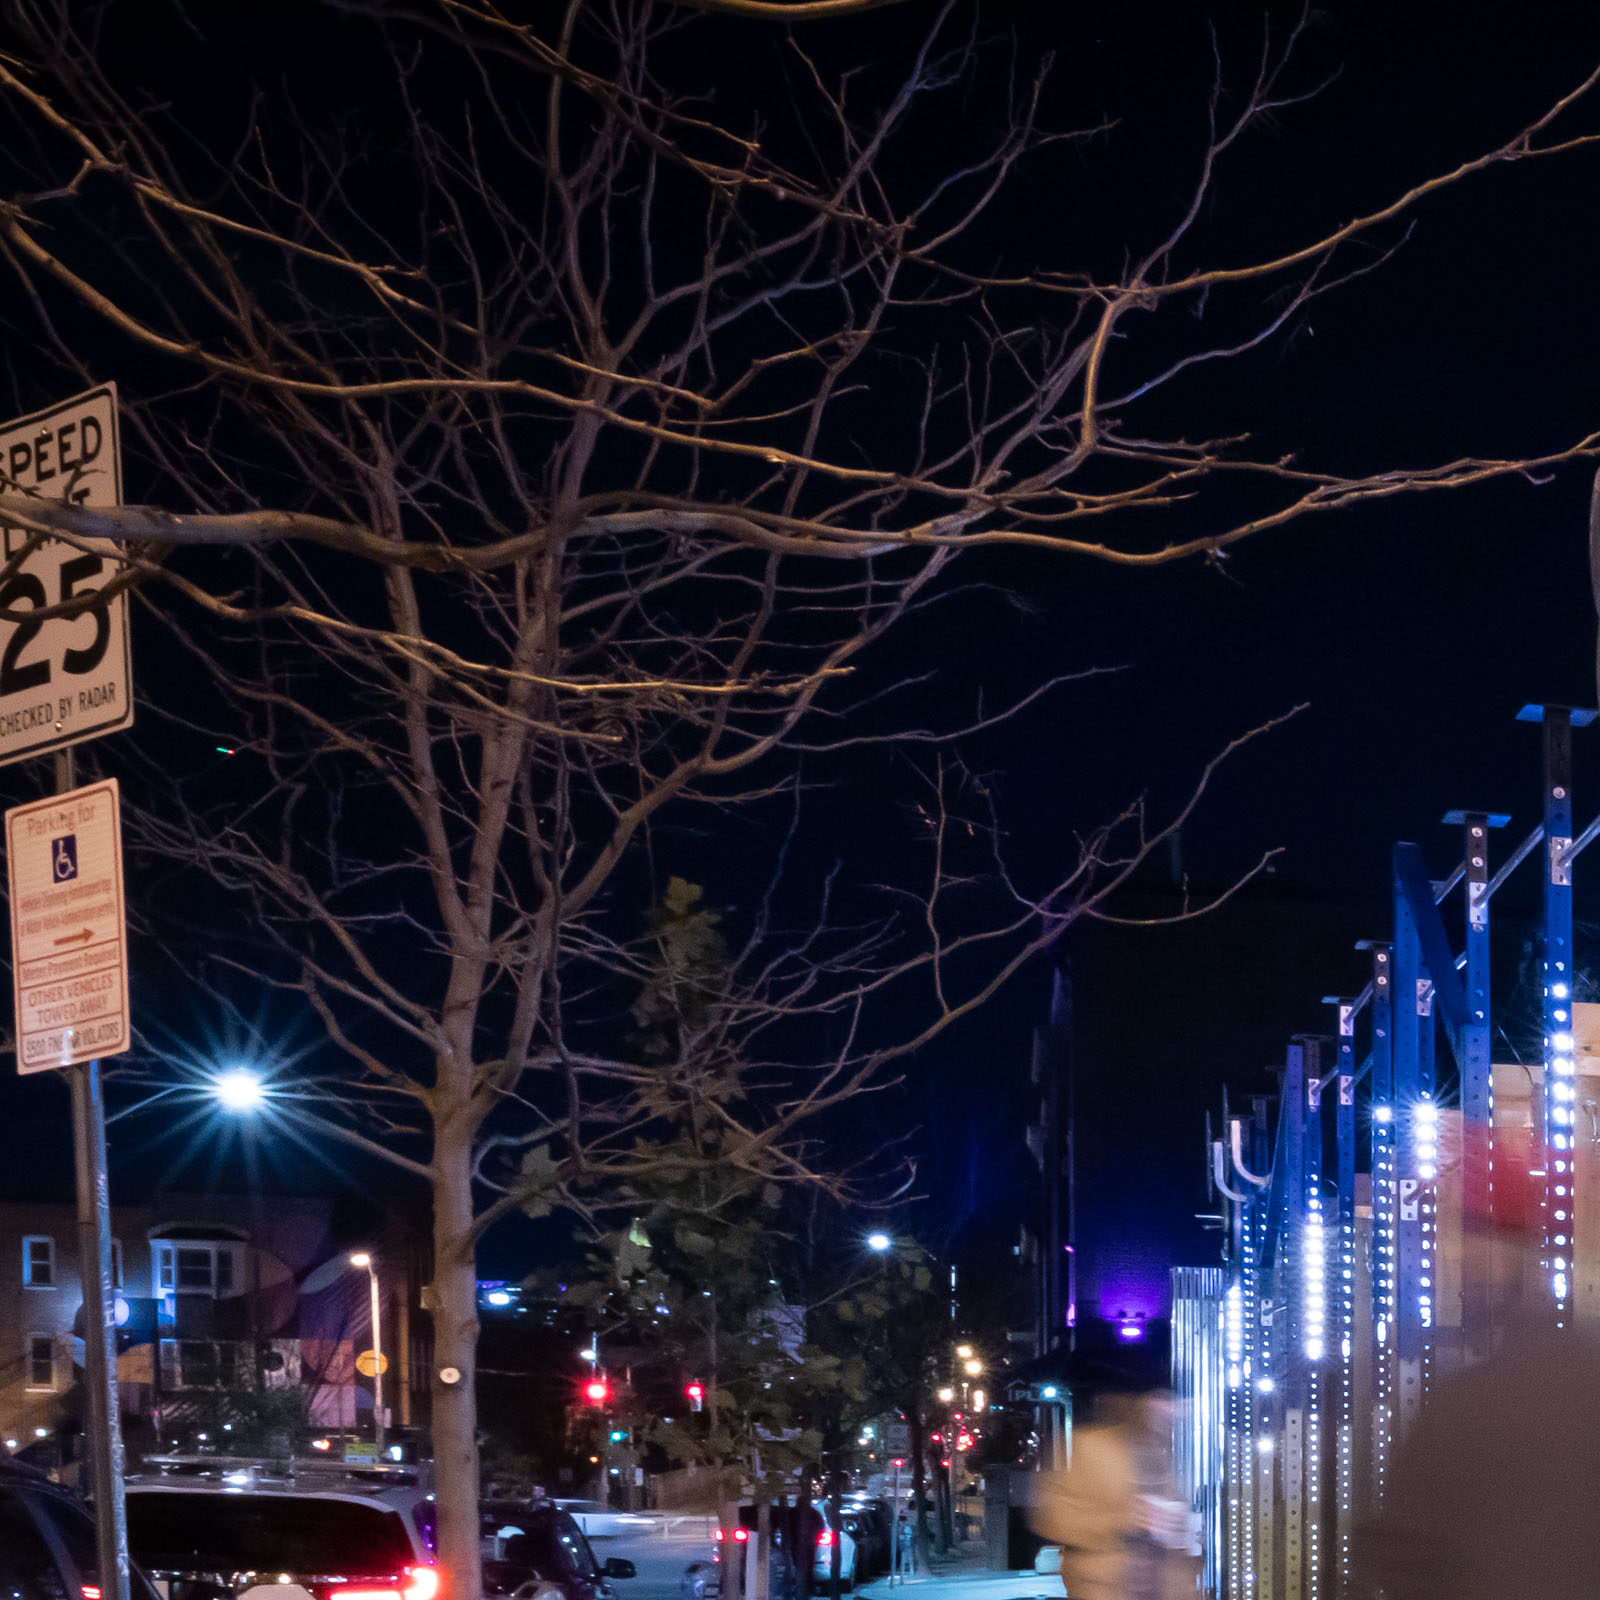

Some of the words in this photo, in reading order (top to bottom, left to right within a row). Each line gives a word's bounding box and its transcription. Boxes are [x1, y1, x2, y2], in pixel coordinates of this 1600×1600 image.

[0, 550, 111, 697] 25
[0, 703, 53, 737] CHECKED
[59, 697, 73, 719] BY
[79, 682, 116, 712] RADAR
[28, 985, 64, 1007] OTHER
[66, 973, 114, 997] VEHICLES
[37, 1002, 76, 1024] TOWED
